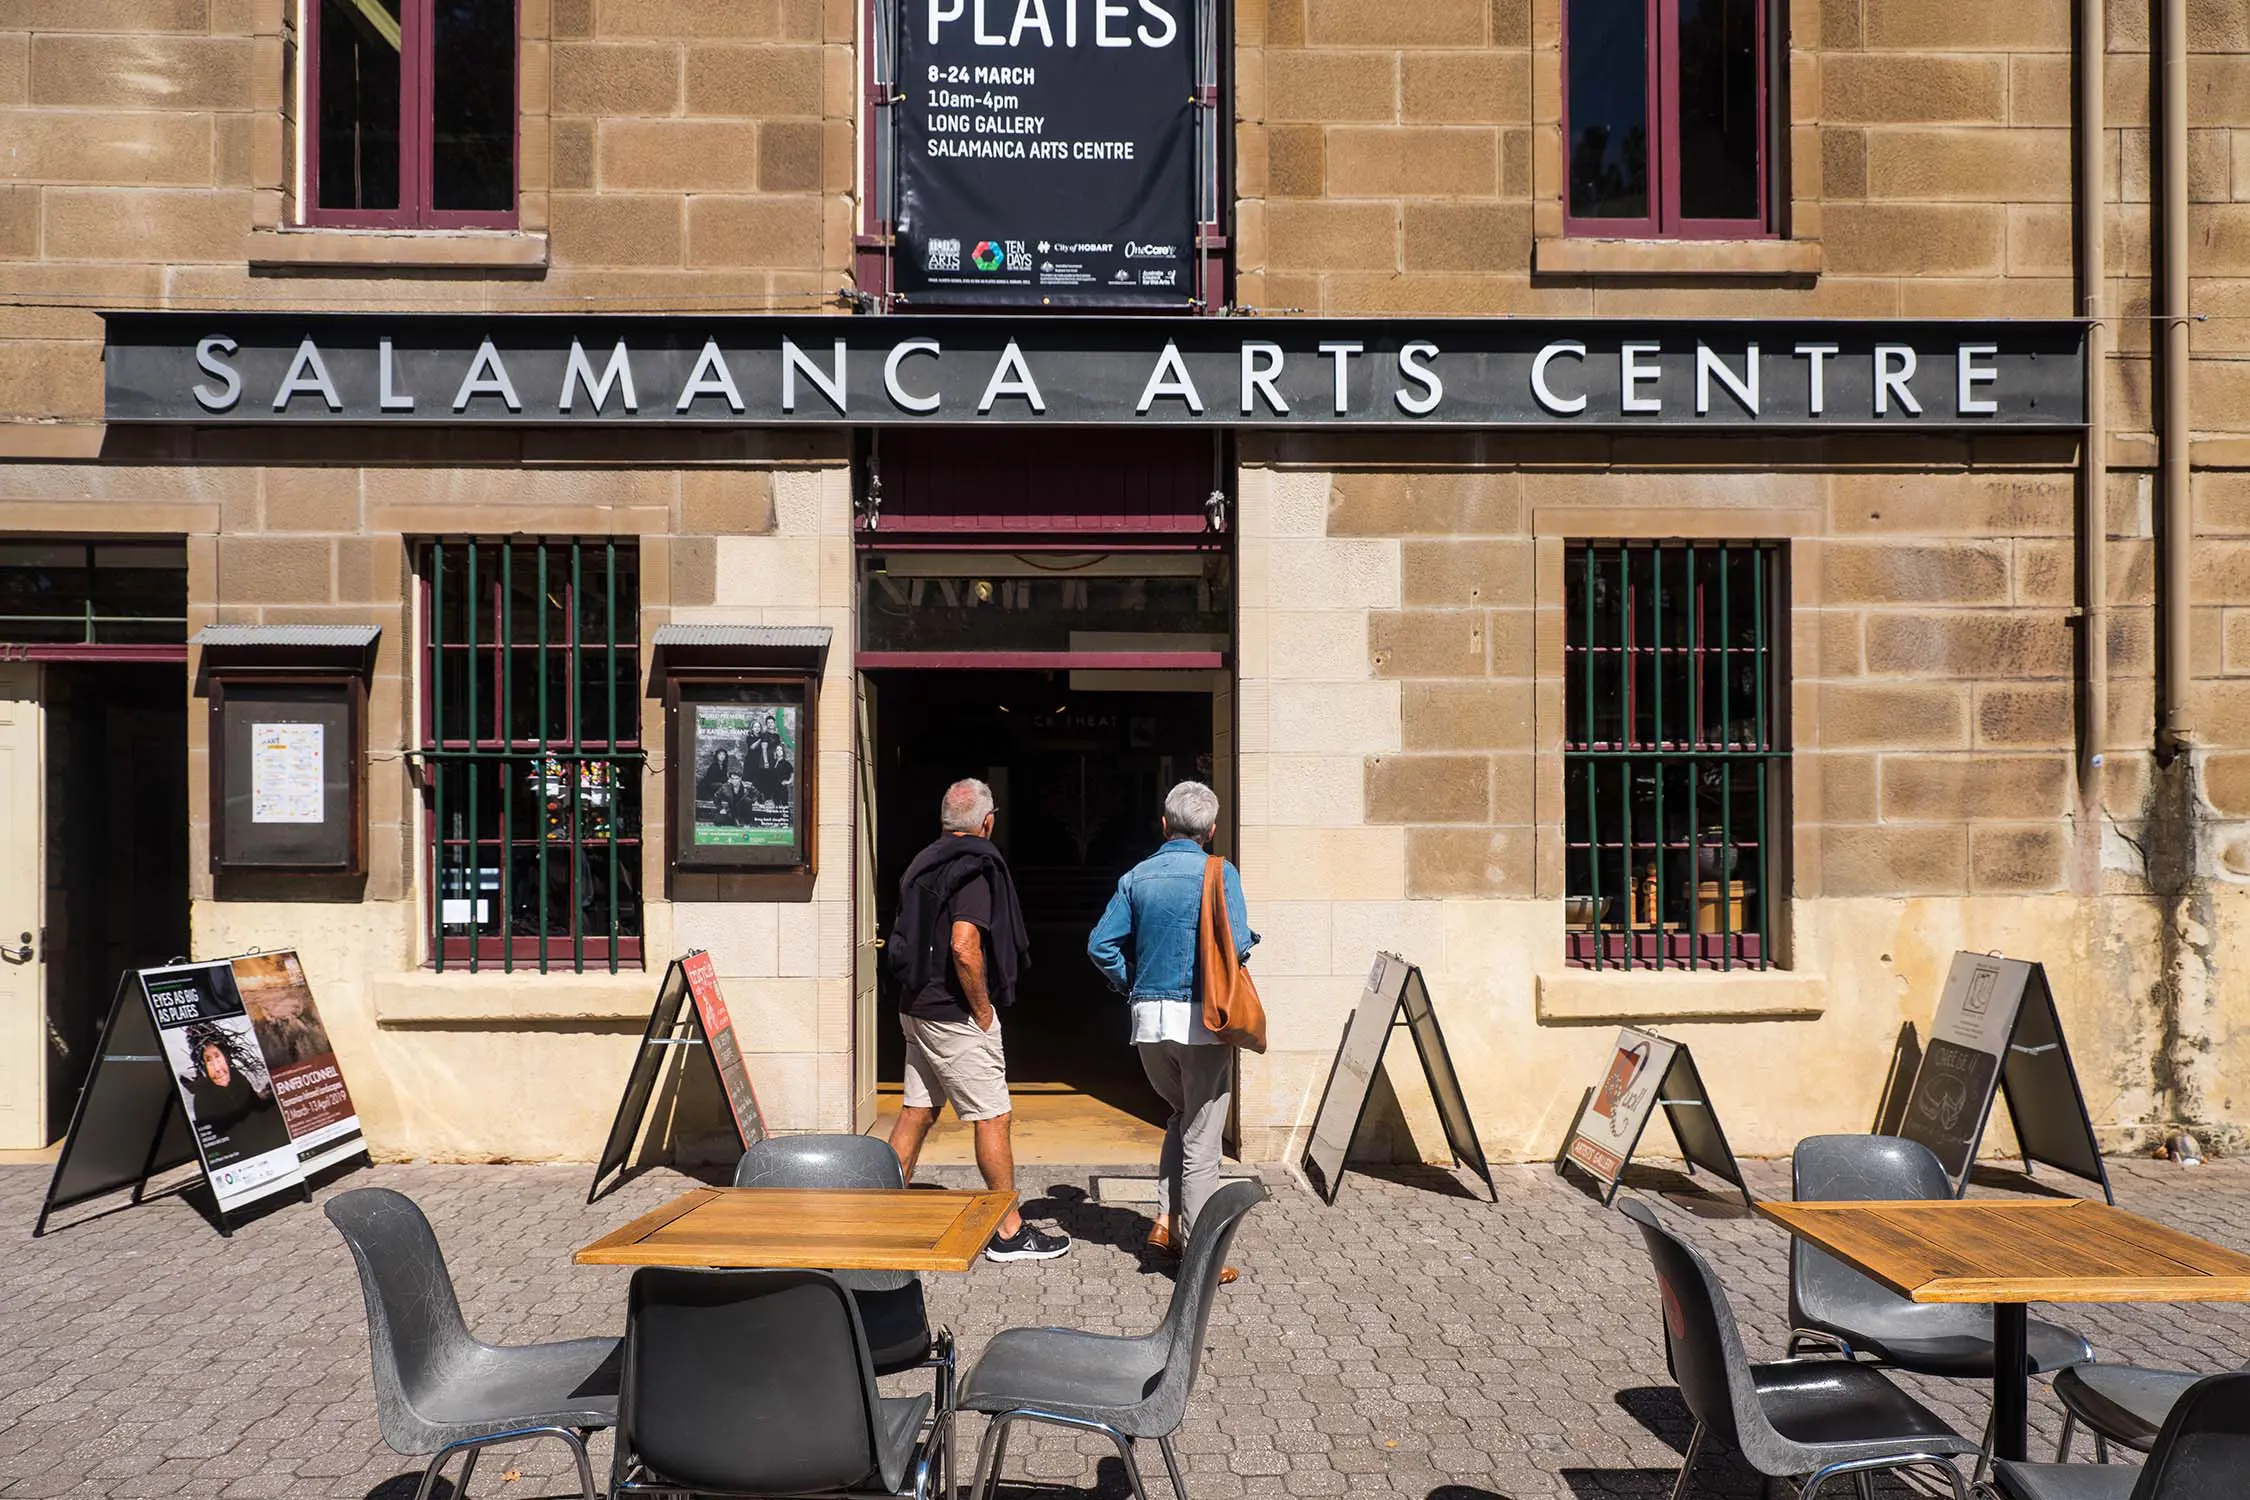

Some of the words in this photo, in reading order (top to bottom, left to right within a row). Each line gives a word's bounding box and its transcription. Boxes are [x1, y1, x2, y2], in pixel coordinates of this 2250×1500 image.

[927, 64, 970, 84] 8-24
[974, 66, 1035, 86] MARCH
[928, 89, 1019, 112] 10am-4pm
[927, 113, 970, 133] LONG
[974, 115, 1045, 135] GALLERY
[927, 138, 1026, 159] SALAMANCA
[1029, 141, 1069, 160] ARTS
[1073, 141, 1134, 160] CENTRE
[1004, 240, 1025, 254] TEN
[1078, 243, 1114, 252] HOBART
[1006, 253, 1032, 267] DAYS
[191, 335, 1048, 414] SALAMANCA
[1135, 340, 1446, 415] ARTS
[1530, 340, 2001, 417] CENTRE
[151, 992, 174, 1008] EYES
[173, 990, 186, 1005] AS
[183, 988, 199, 1004] BIG
[158, 1008, 171, 1023] AS
[168, 1004, 200, 1021] PLATES
